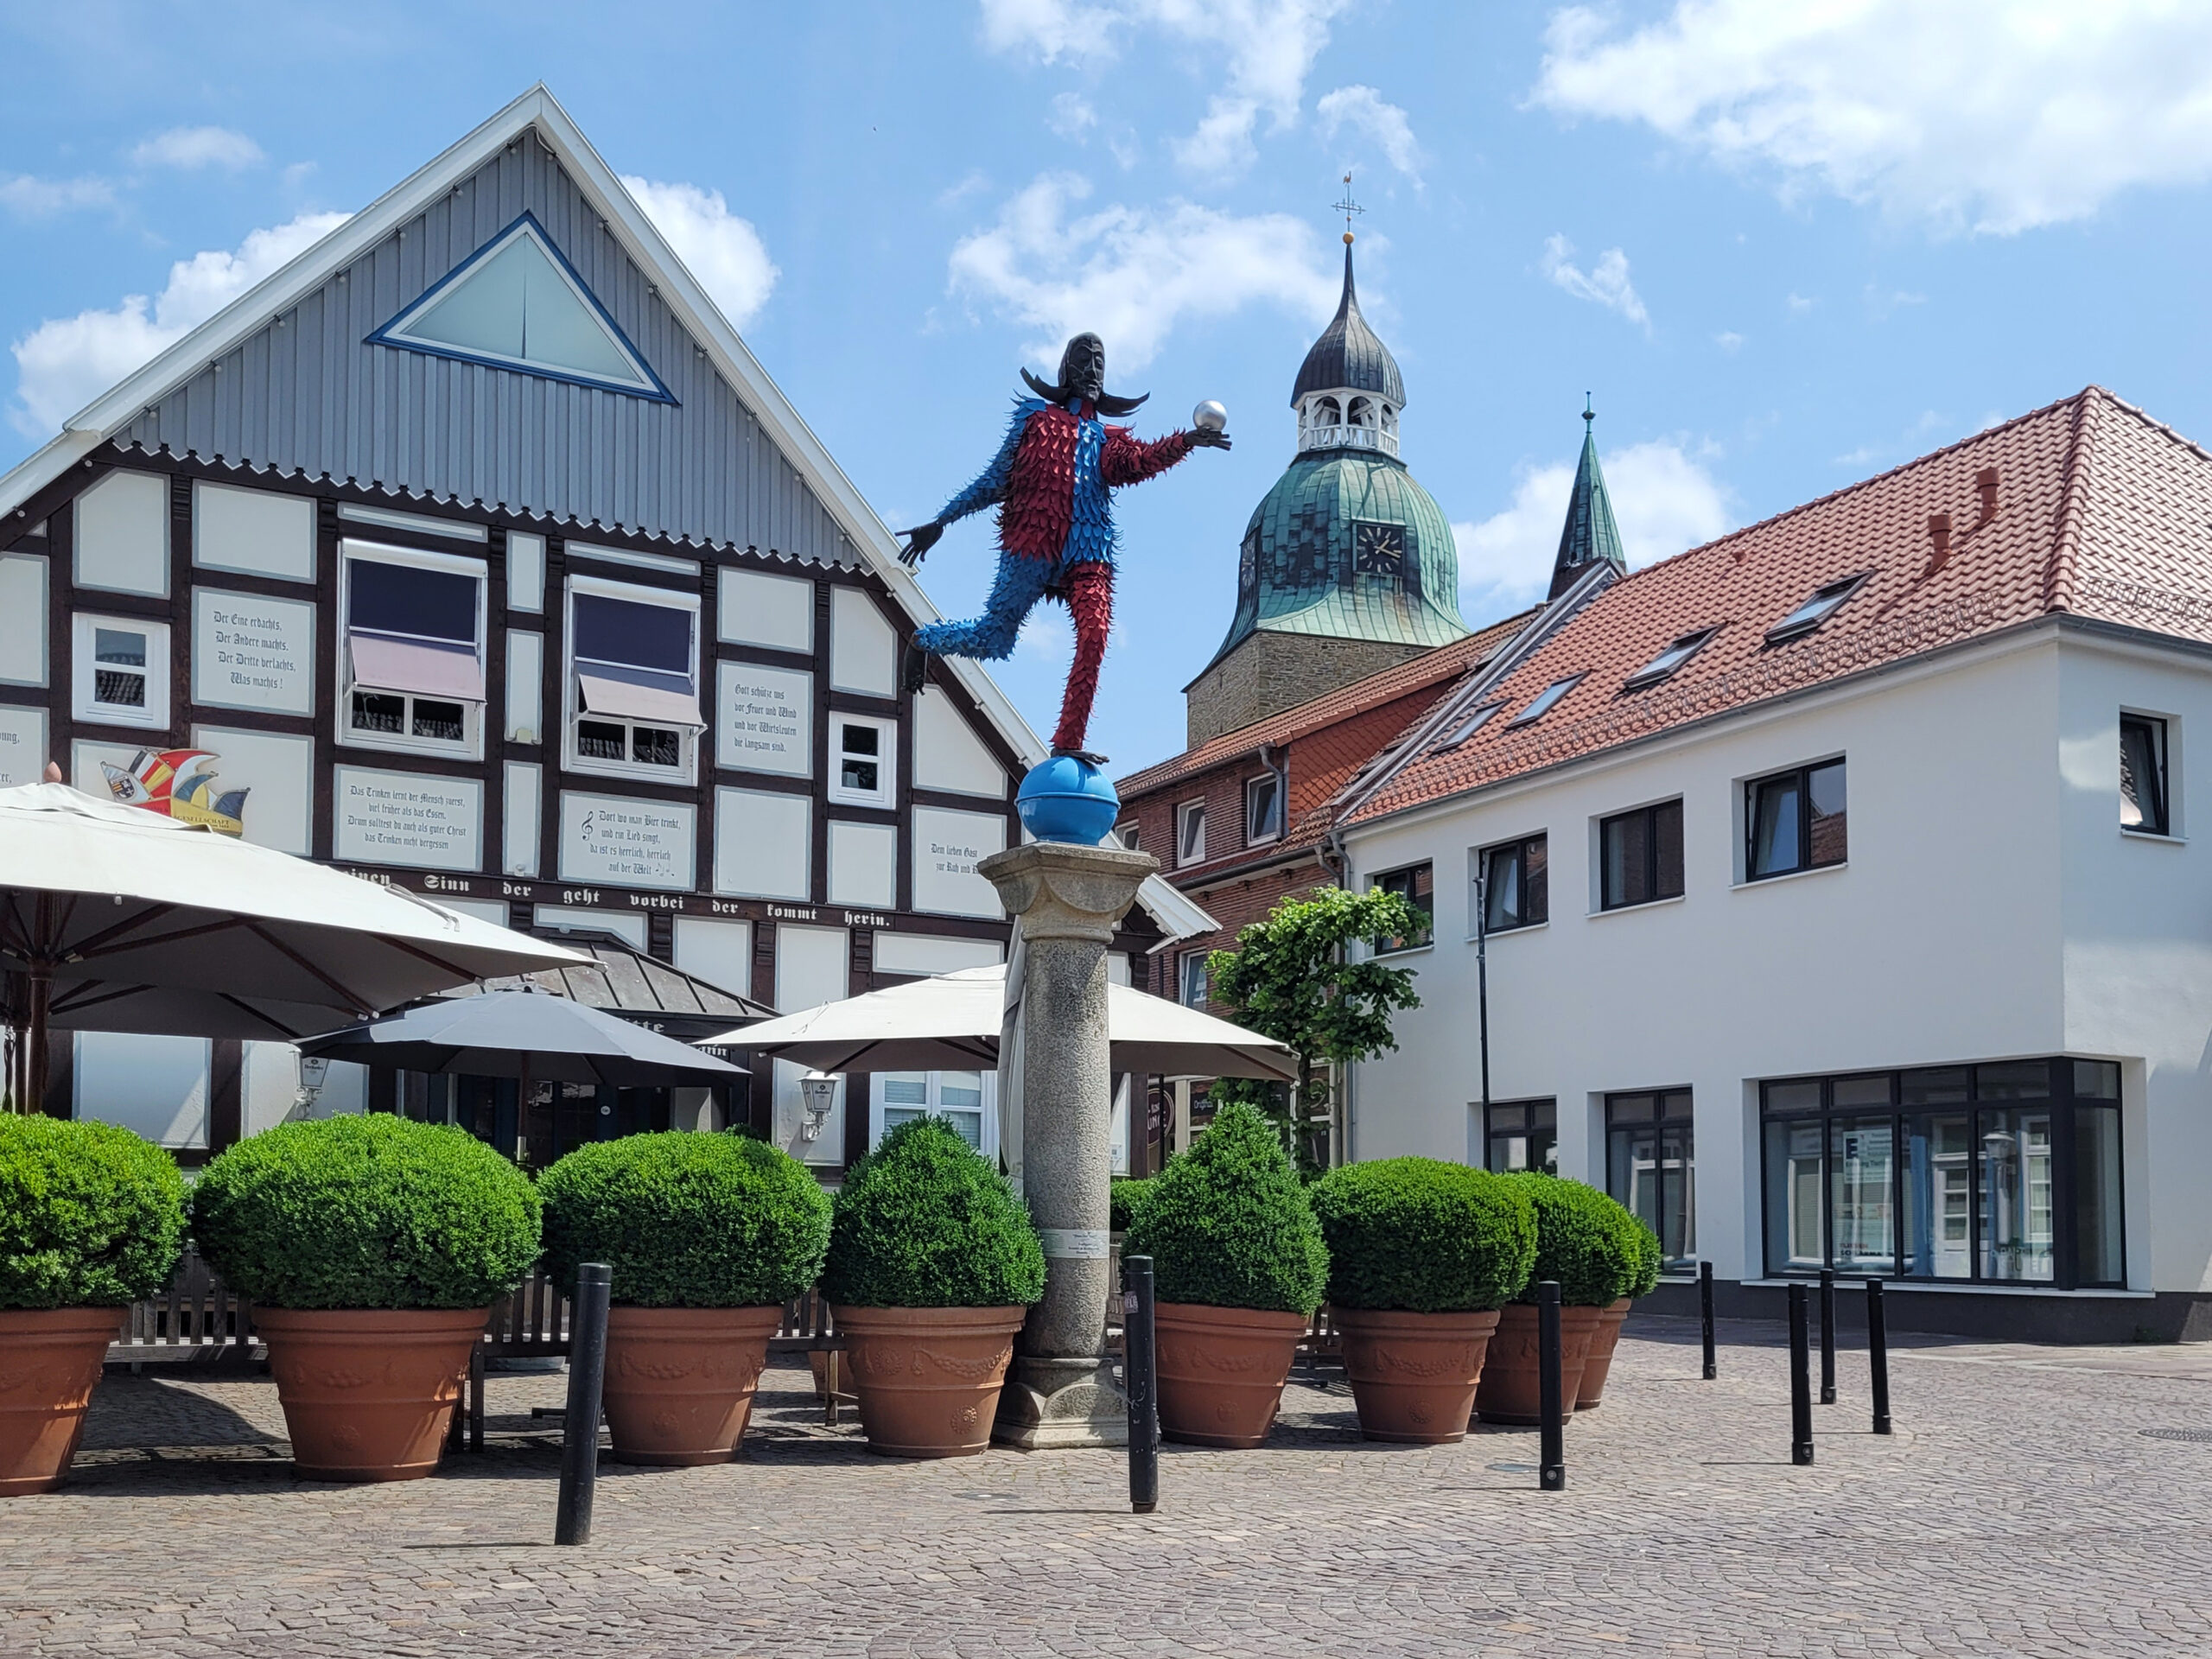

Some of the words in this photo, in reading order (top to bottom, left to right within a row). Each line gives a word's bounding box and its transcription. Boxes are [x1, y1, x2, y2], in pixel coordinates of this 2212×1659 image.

[214, 611, 228, 623] Der
[232, 613, 248, 626] Eine
[216, 631, 231, 643] Der
[218, 651, 233, 664] Der
[231, 671, 251, 685] Was
[766, 707, 777, 715] und
[734, 721, 746, 730] und
[351, 785, 364, 796] Das
[409, 792, 418, 801] der
[601, 829, 613, 838] und
[423, 874, 470, 892] Sinn
[502, 881, 531, 897] der
[563, 888, 601, 906] geht
[629, 894, 683, 909] vorbei
[712, 900, 739, 914] der
[766, 903, 817, 920] kommt
